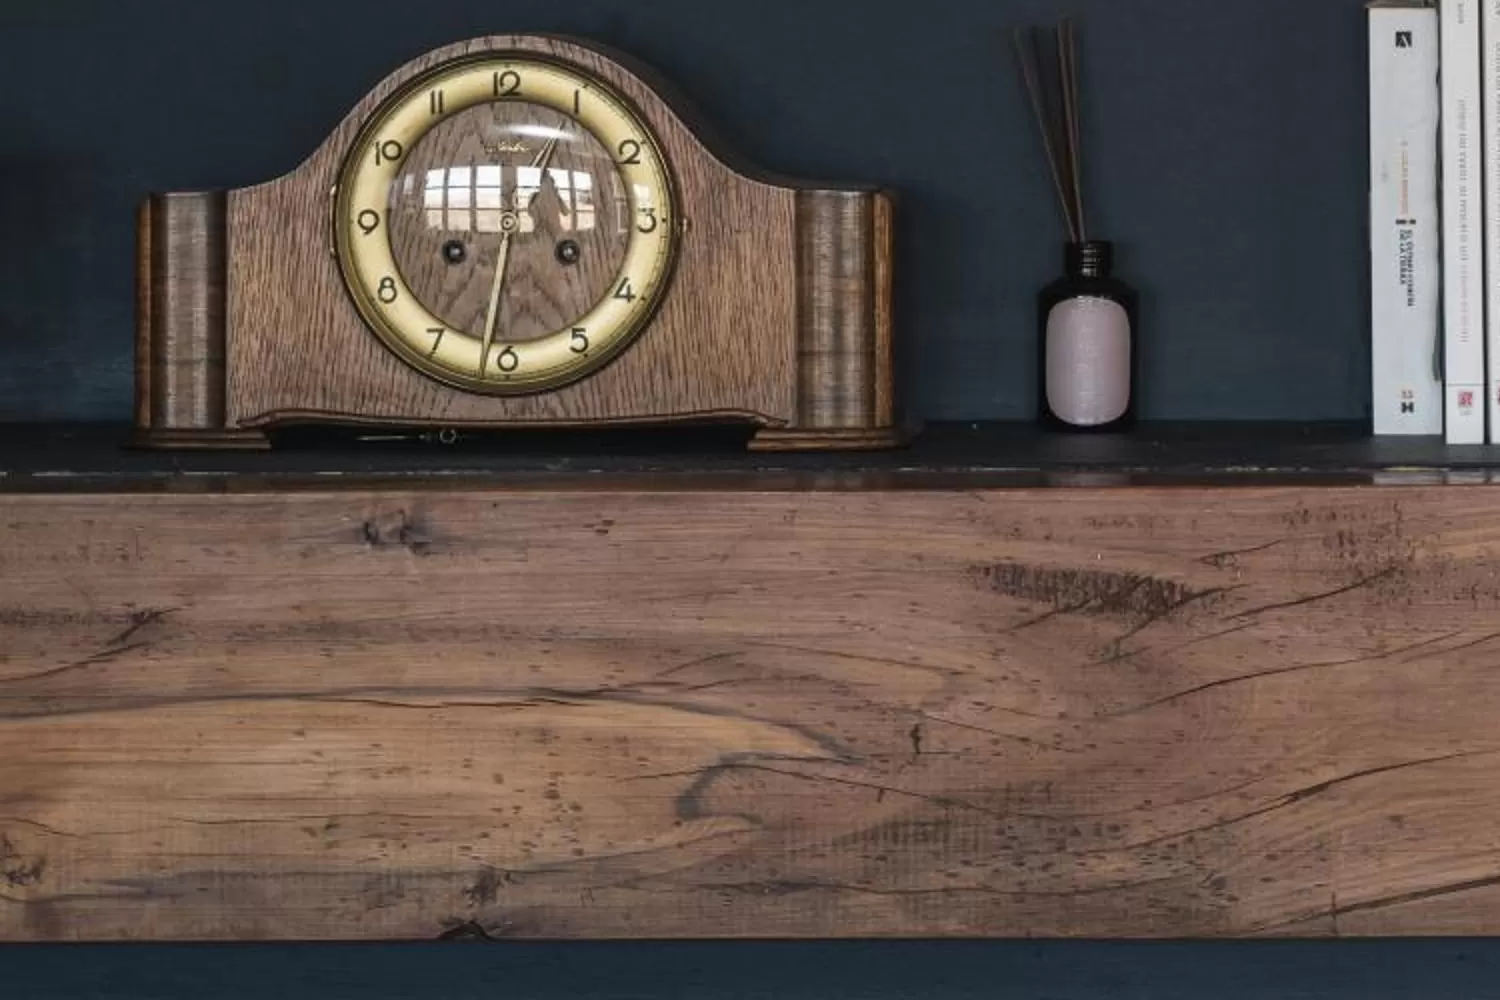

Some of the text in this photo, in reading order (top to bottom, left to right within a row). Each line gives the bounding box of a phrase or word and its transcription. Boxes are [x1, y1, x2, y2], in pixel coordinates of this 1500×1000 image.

[493, 71, 523, 97] 12
[430, 88, 443, 115] 11
[574, 88, 580, 115] 1
[375, 139, 402, 166] 10
[617, 139, 641, 165] 2
[357, 209, 380, 236] 9
[636, 207, 657, 234] 3
[376, 276, 398, 303] 8
[614, 277, 636, 303] 4
[426, 328, 445, 354] 7
[570, 328, 590, 353] 5
[496, 345, 518, 372] 6
